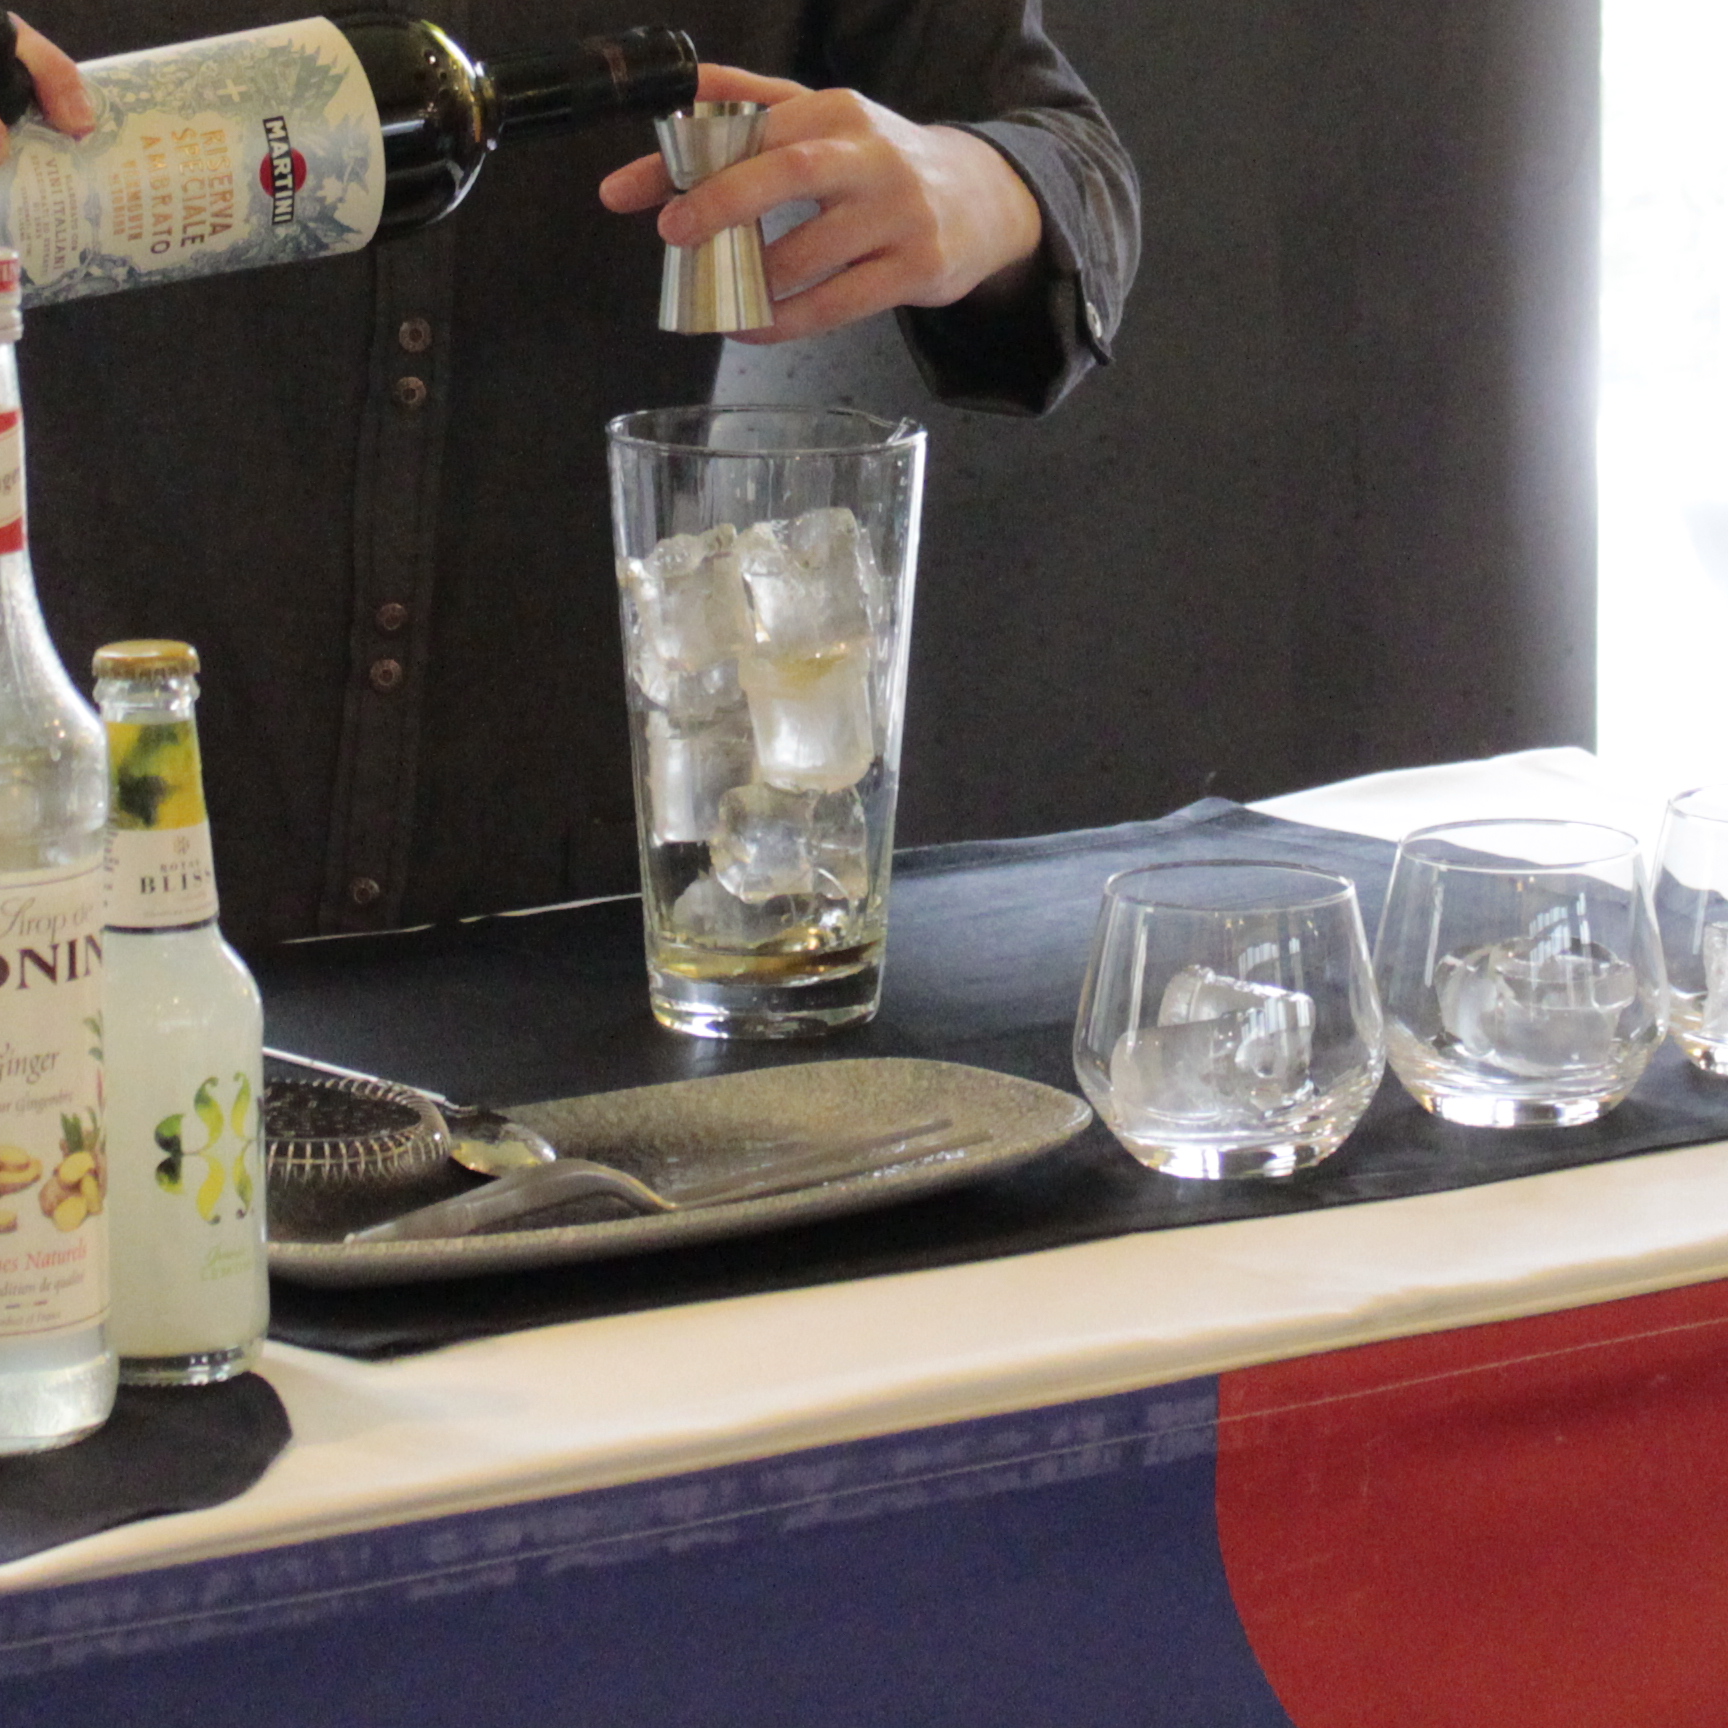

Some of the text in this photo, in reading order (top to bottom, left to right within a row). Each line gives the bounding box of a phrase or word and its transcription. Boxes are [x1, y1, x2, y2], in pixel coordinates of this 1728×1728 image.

[46, 157, 67, 270] VINI ITALIANI
[140, 135, 173, 255] AMBRATO
[172, 127, 207, 248] SPECIALE
[200, 129, 234, 237] RISERVA
[265, 119, 292, 223] MARTINI
[72, 904, 93, 926] de
[24, 1238, 88, 1271] Naturels
[38, 1276, 52, 1292] de
